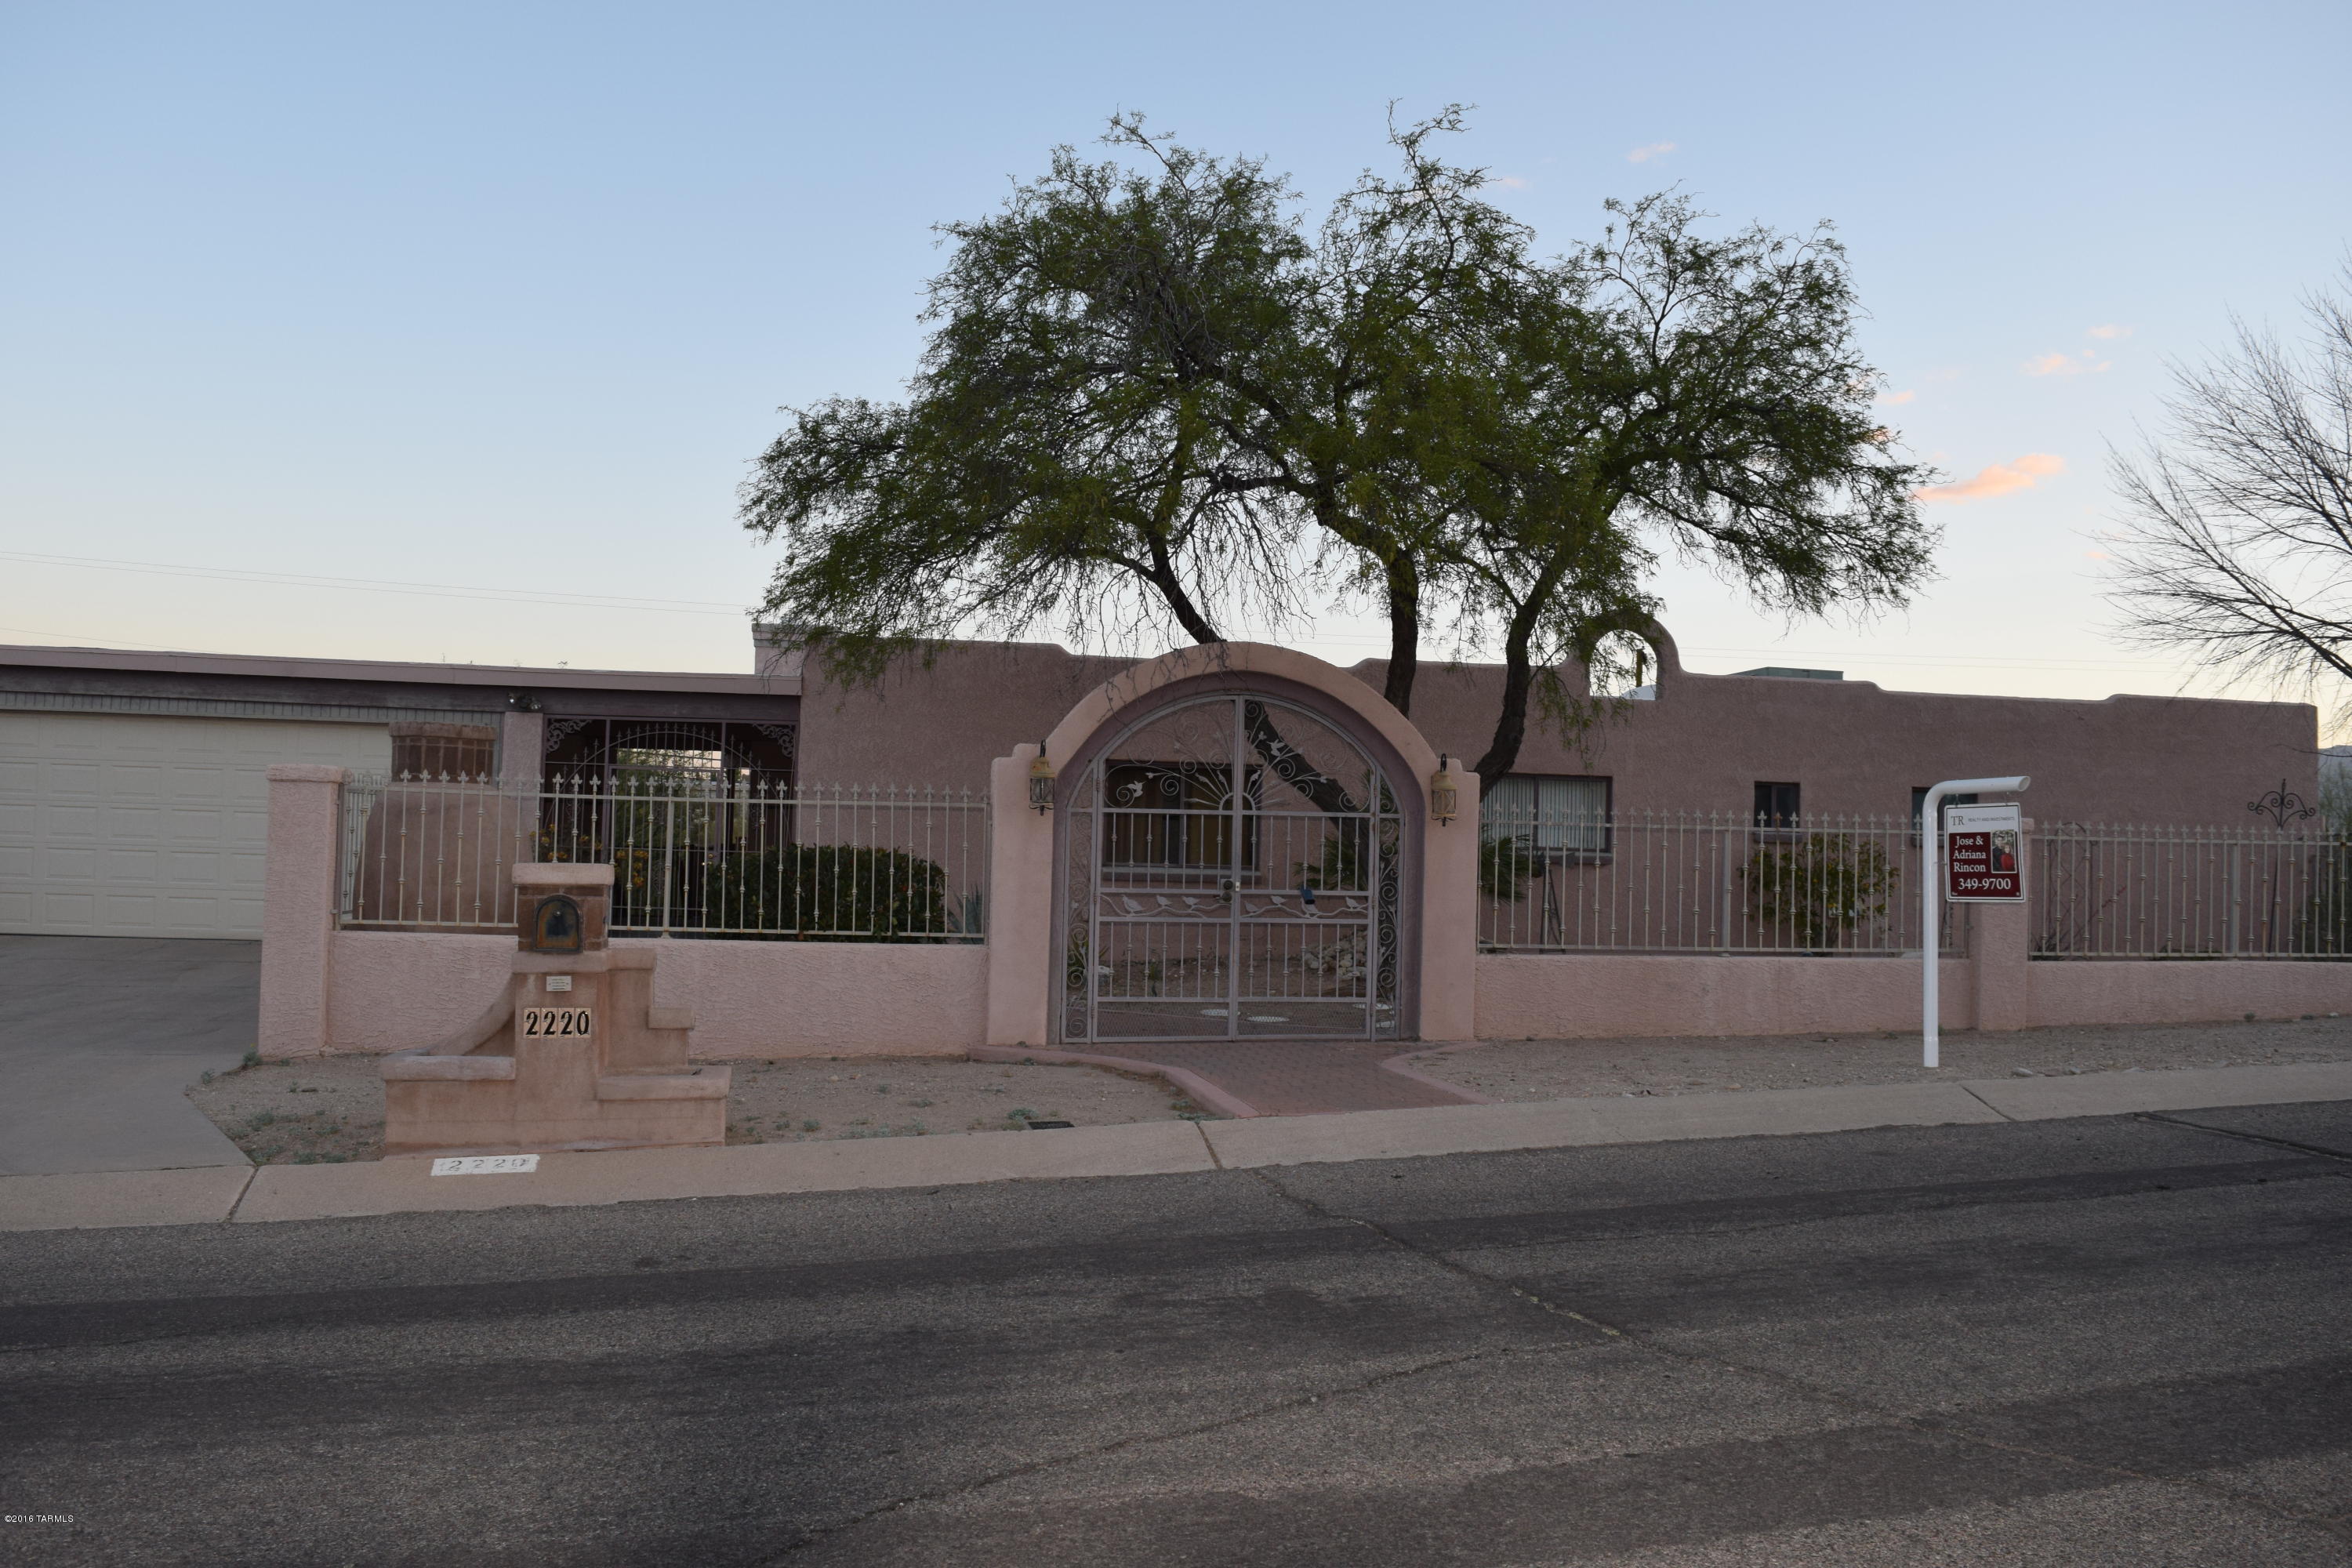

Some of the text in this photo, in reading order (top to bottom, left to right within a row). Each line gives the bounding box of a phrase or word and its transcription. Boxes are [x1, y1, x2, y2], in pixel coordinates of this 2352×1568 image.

[1951, 815, 1965, 826] TR
[1955, 835, 1984, 848] Jose &
[1953, 849, 1987, 859] Adriana
[1953, 862, 1987, 873] Rincon
[1958, 877, 2011, 891] 349-9700
[525, 1010, 590, 1036] 2220
